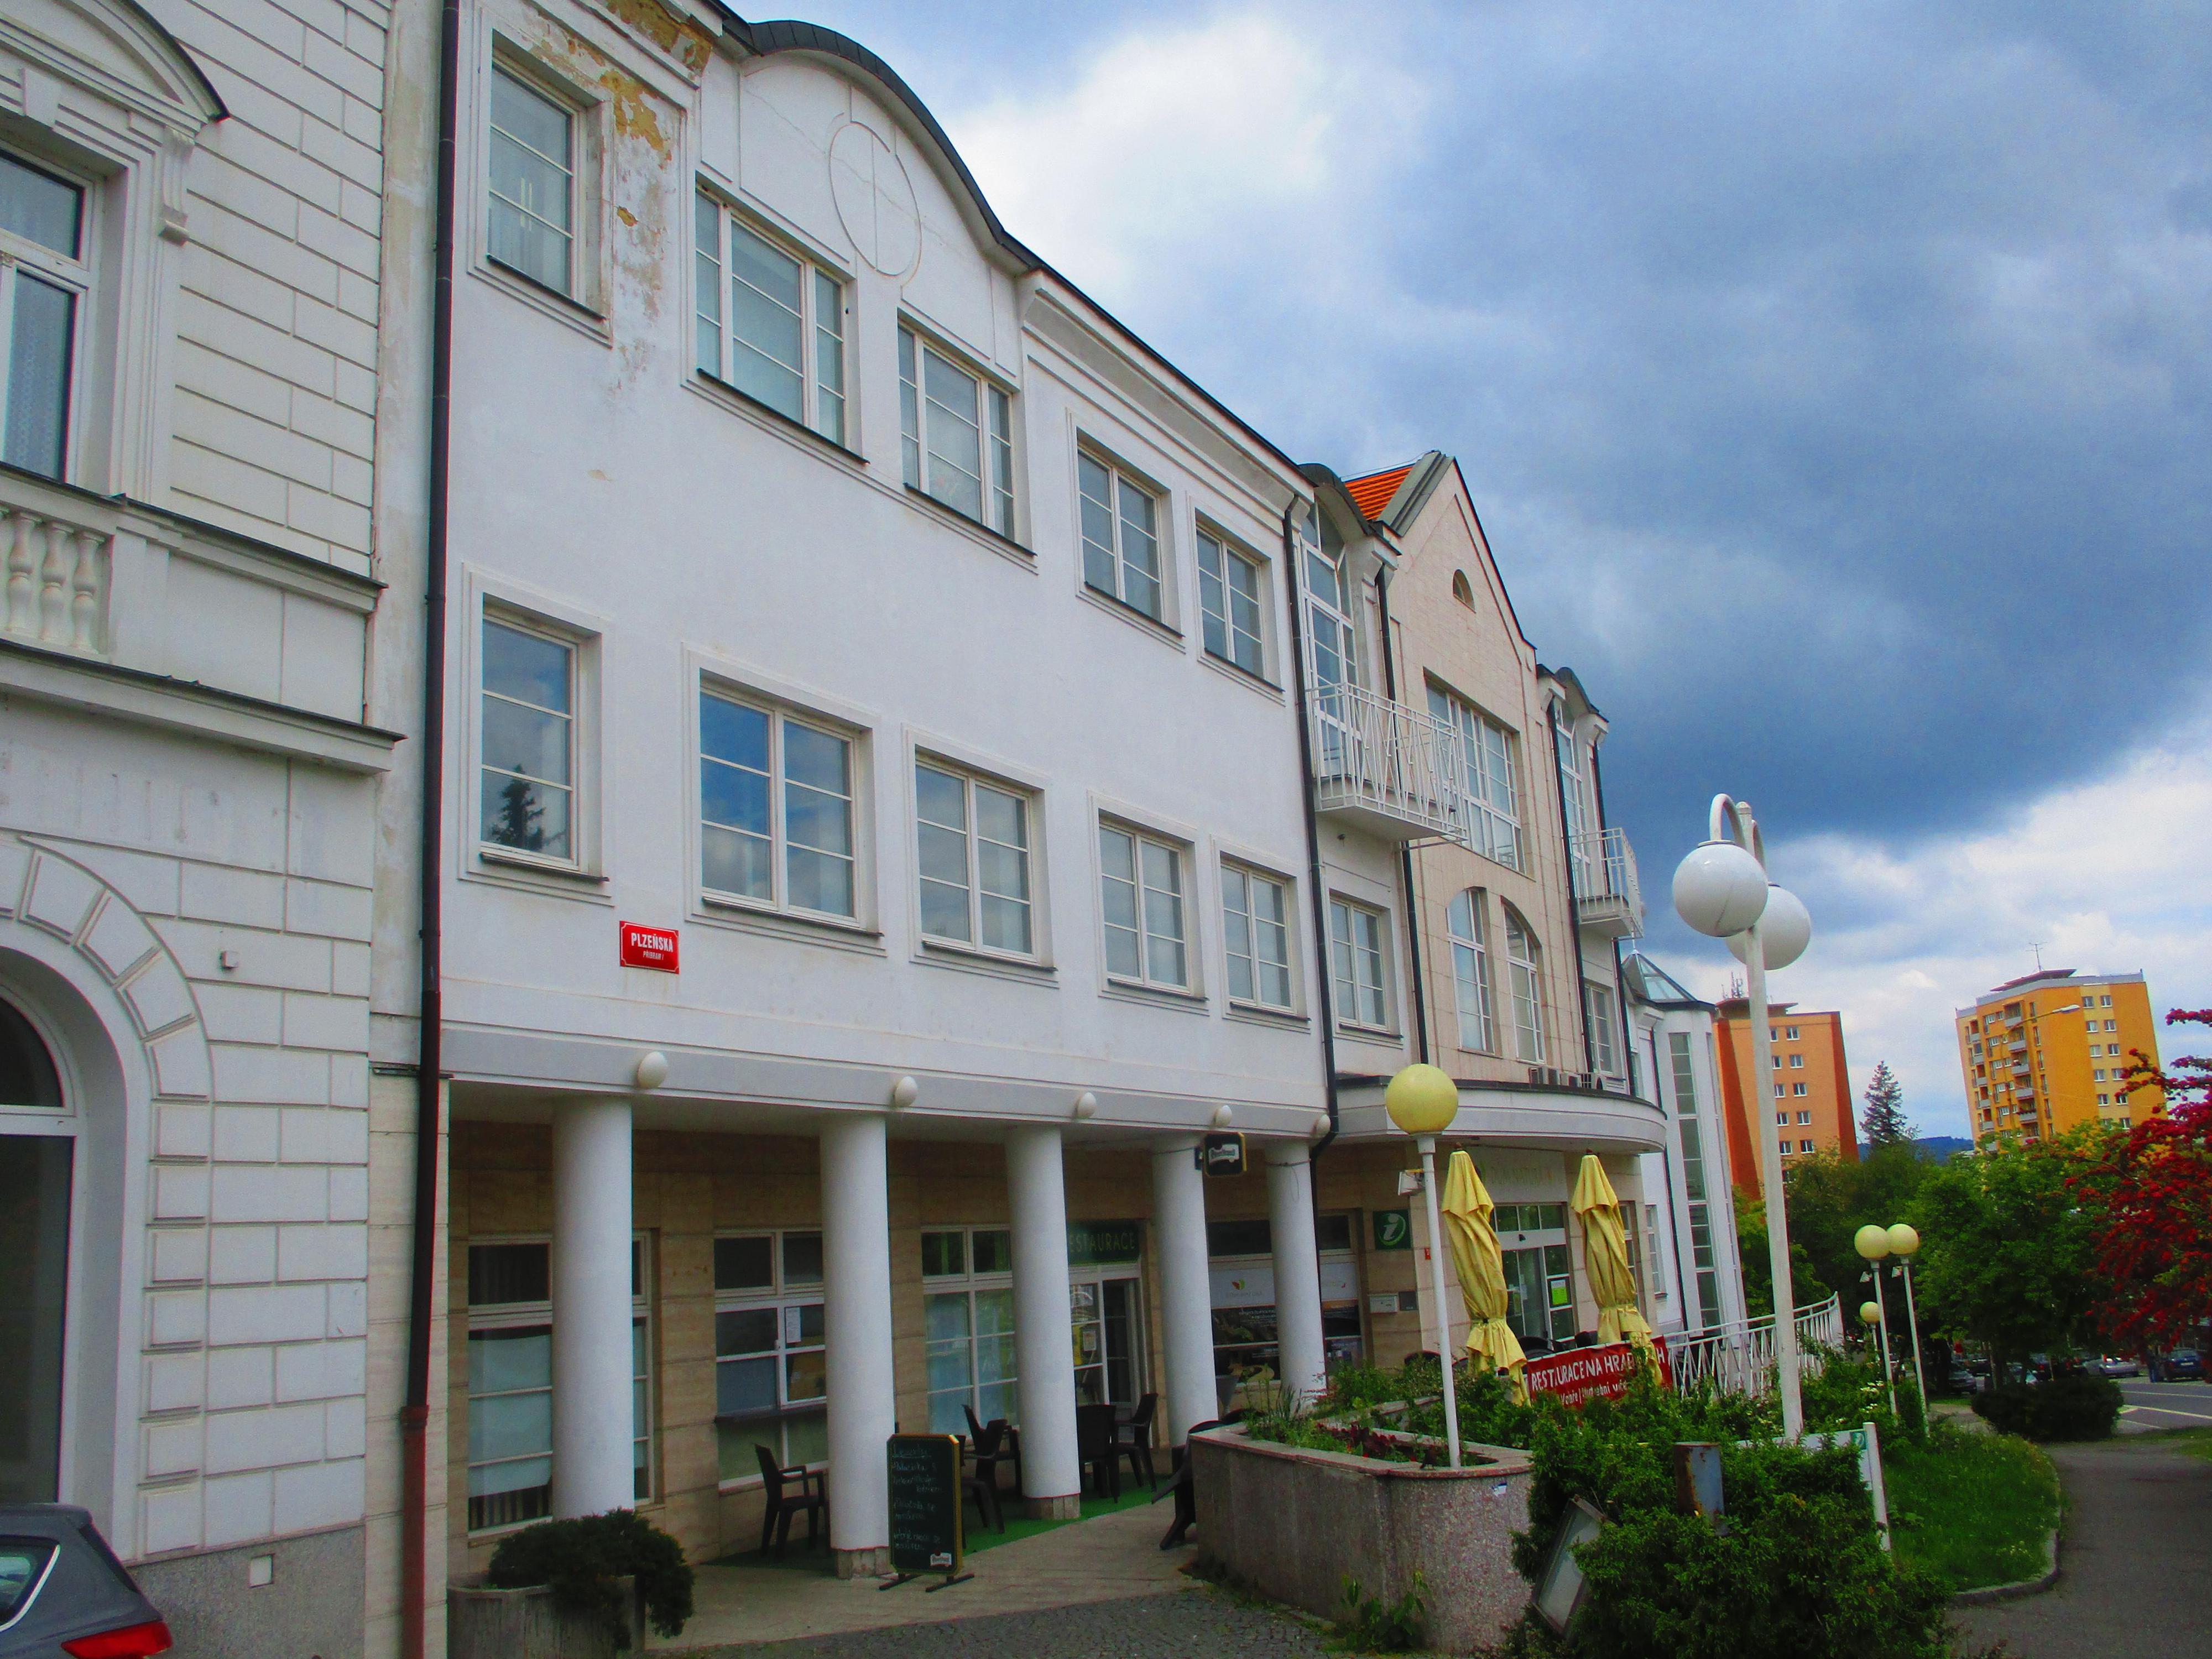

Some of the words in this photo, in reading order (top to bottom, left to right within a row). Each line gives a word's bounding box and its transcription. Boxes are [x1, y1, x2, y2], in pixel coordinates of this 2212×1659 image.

[631, 932, 673, 952] PLZEŇSKÁ
[1070, 1231, 1135, 1253] ESTAURACE
[1585, 1358, 1603, 1378] NA
